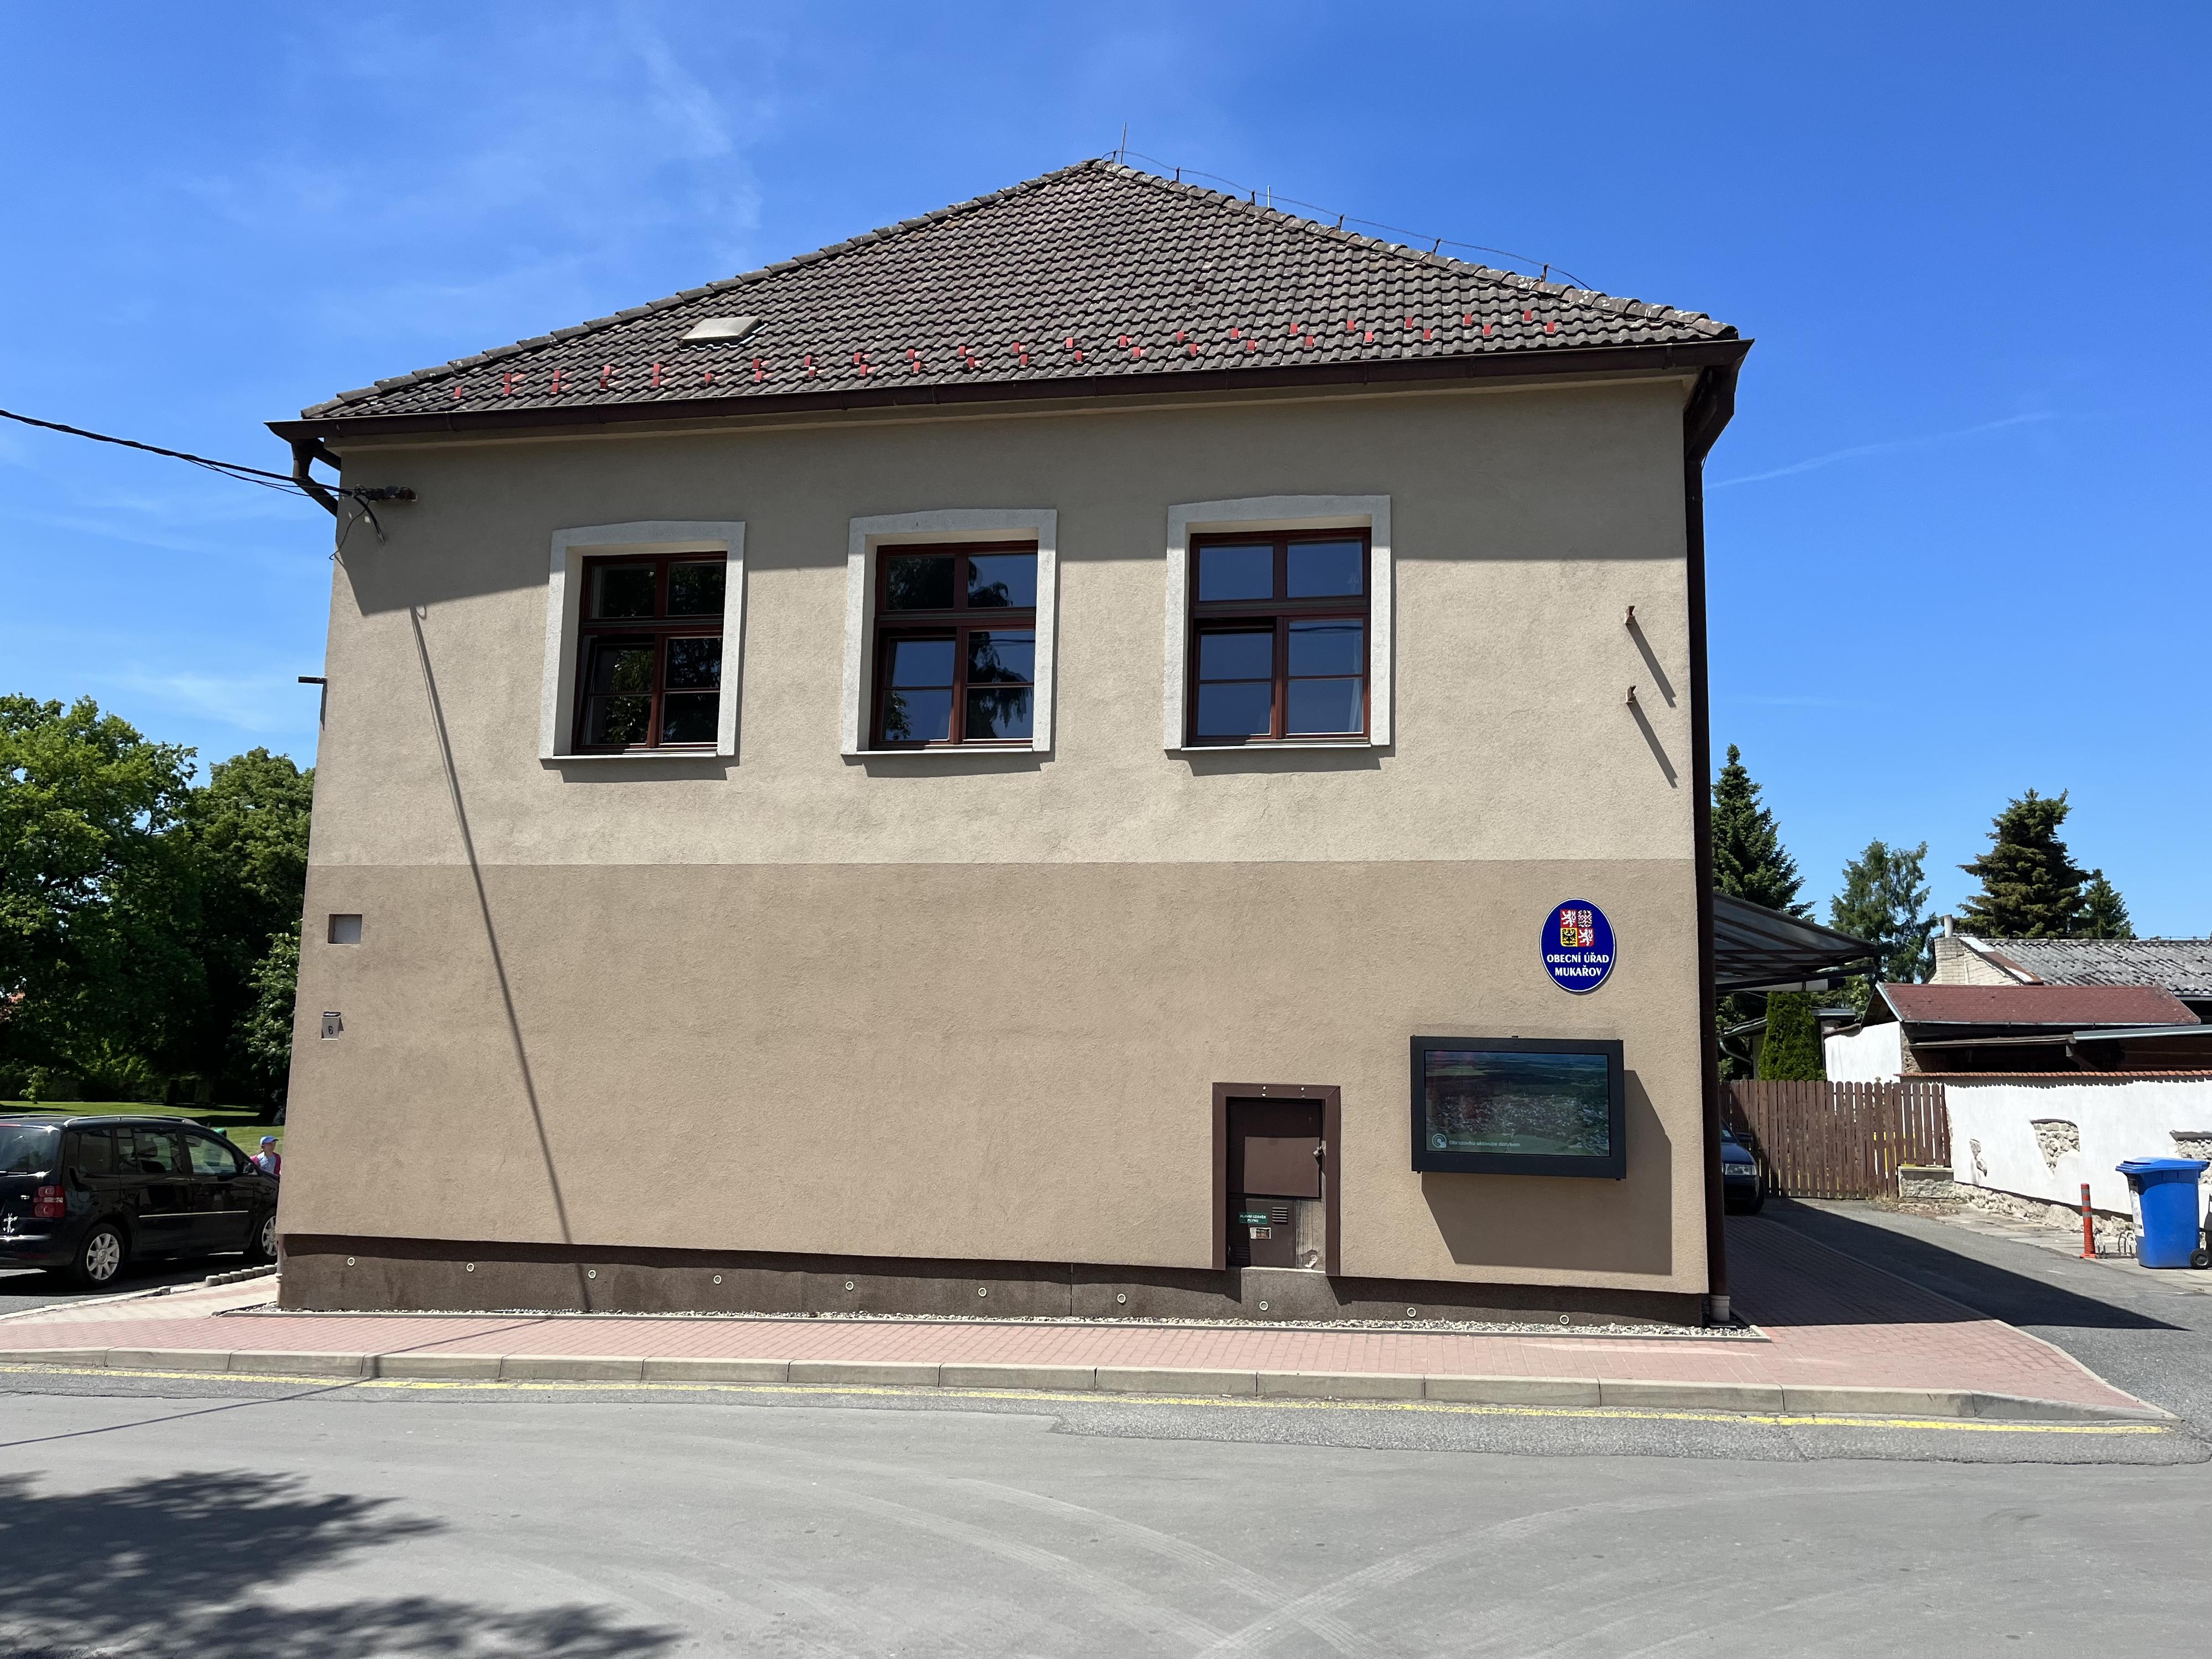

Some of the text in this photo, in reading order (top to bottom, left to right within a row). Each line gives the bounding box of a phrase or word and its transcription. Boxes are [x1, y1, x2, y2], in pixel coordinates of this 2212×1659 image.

[1547, 952, 1609, 963] OBECNÍ ÚŘAD
[1555, 965, 1602, 977] MUKAŘOV
